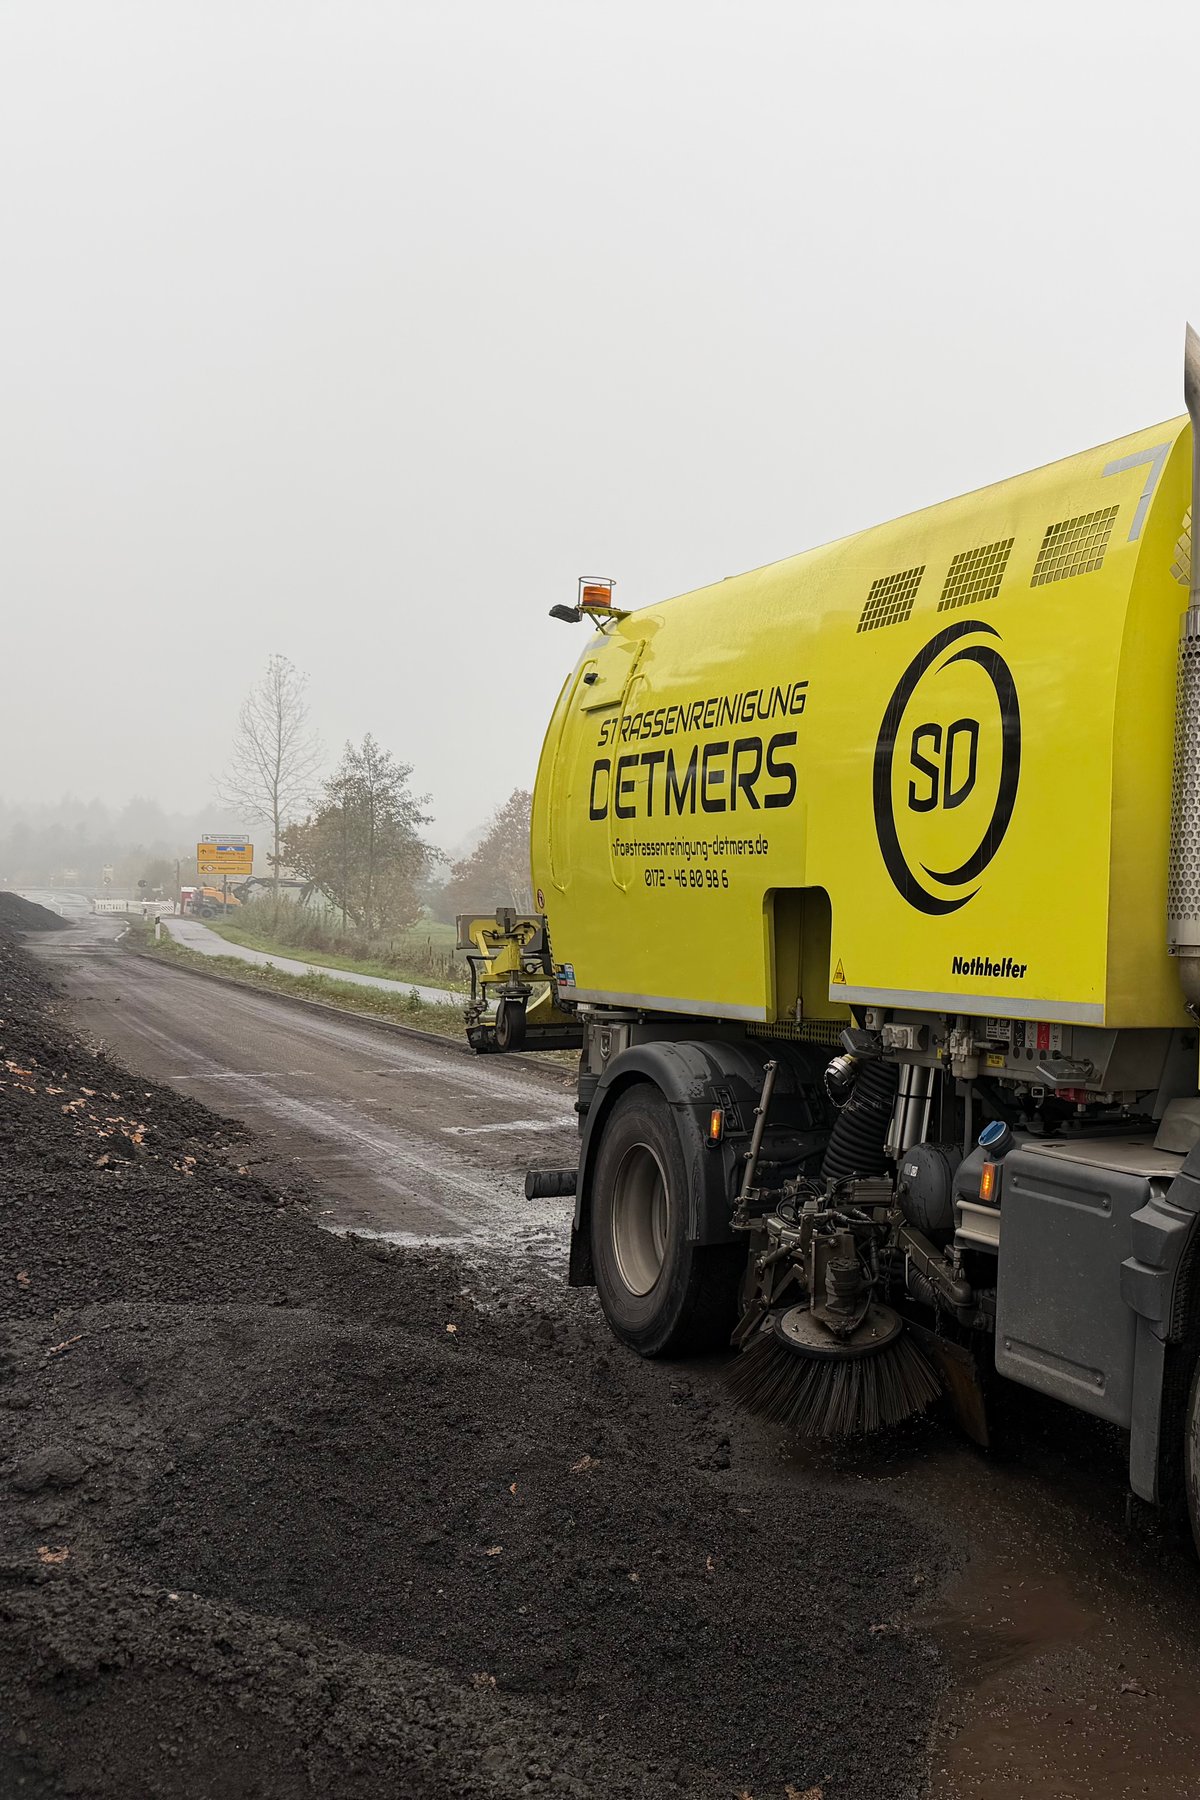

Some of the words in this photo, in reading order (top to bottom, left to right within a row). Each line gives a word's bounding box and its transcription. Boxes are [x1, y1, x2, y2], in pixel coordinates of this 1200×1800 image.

[597, 680, 809, 747] STRASSENREINIGUNG
[589, 731, 798, 821] DETMERS
[908, 718, 980, 813] SD
[612, 834, 768, 861] nfo@strassenreinigung-detmers.de
[645, 869, 665, 886] 0172
[674, 869, 687, 888] 46
[689, 869, 704, 888] 80
[706, 869, 719, 888] 98
[721, 869, 729, 888] 6
[952, 956, 1028, 978] Nothhelfer
